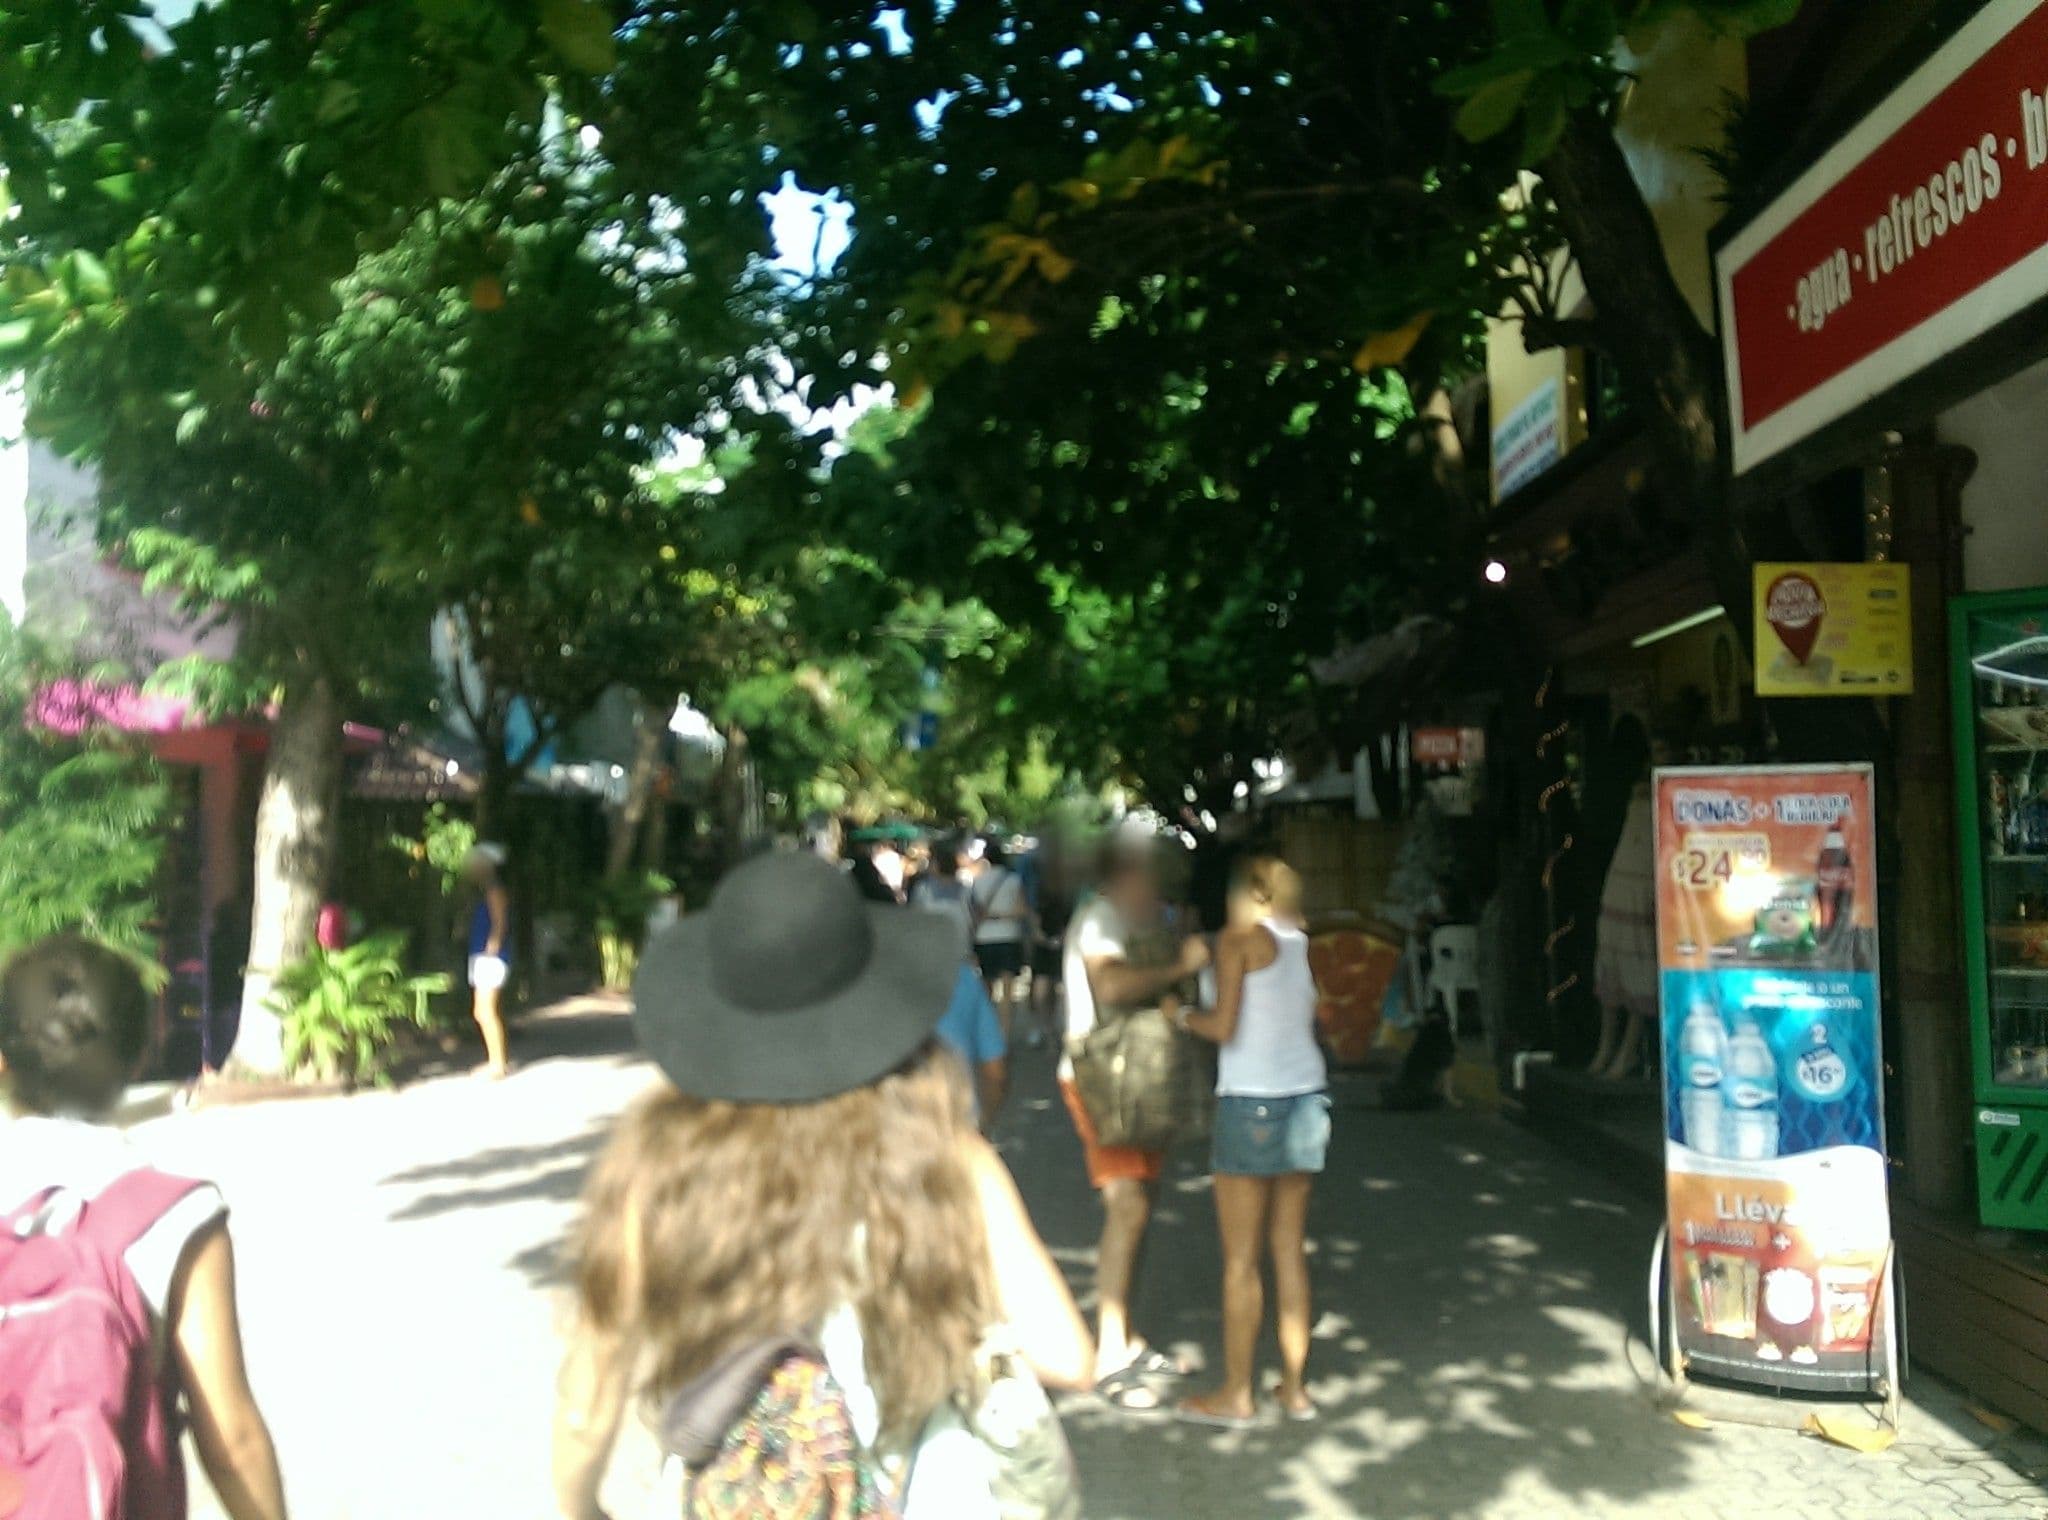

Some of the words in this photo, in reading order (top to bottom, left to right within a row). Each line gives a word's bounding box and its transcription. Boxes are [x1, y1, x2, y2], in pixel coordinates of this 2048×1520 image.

[1796, 247, 1852, 332] agua
[1865, 132, 2001, 283] refrescos
[2021, 84, 2048, 170] b
[1811, 1024, 1828, 1044] 2
